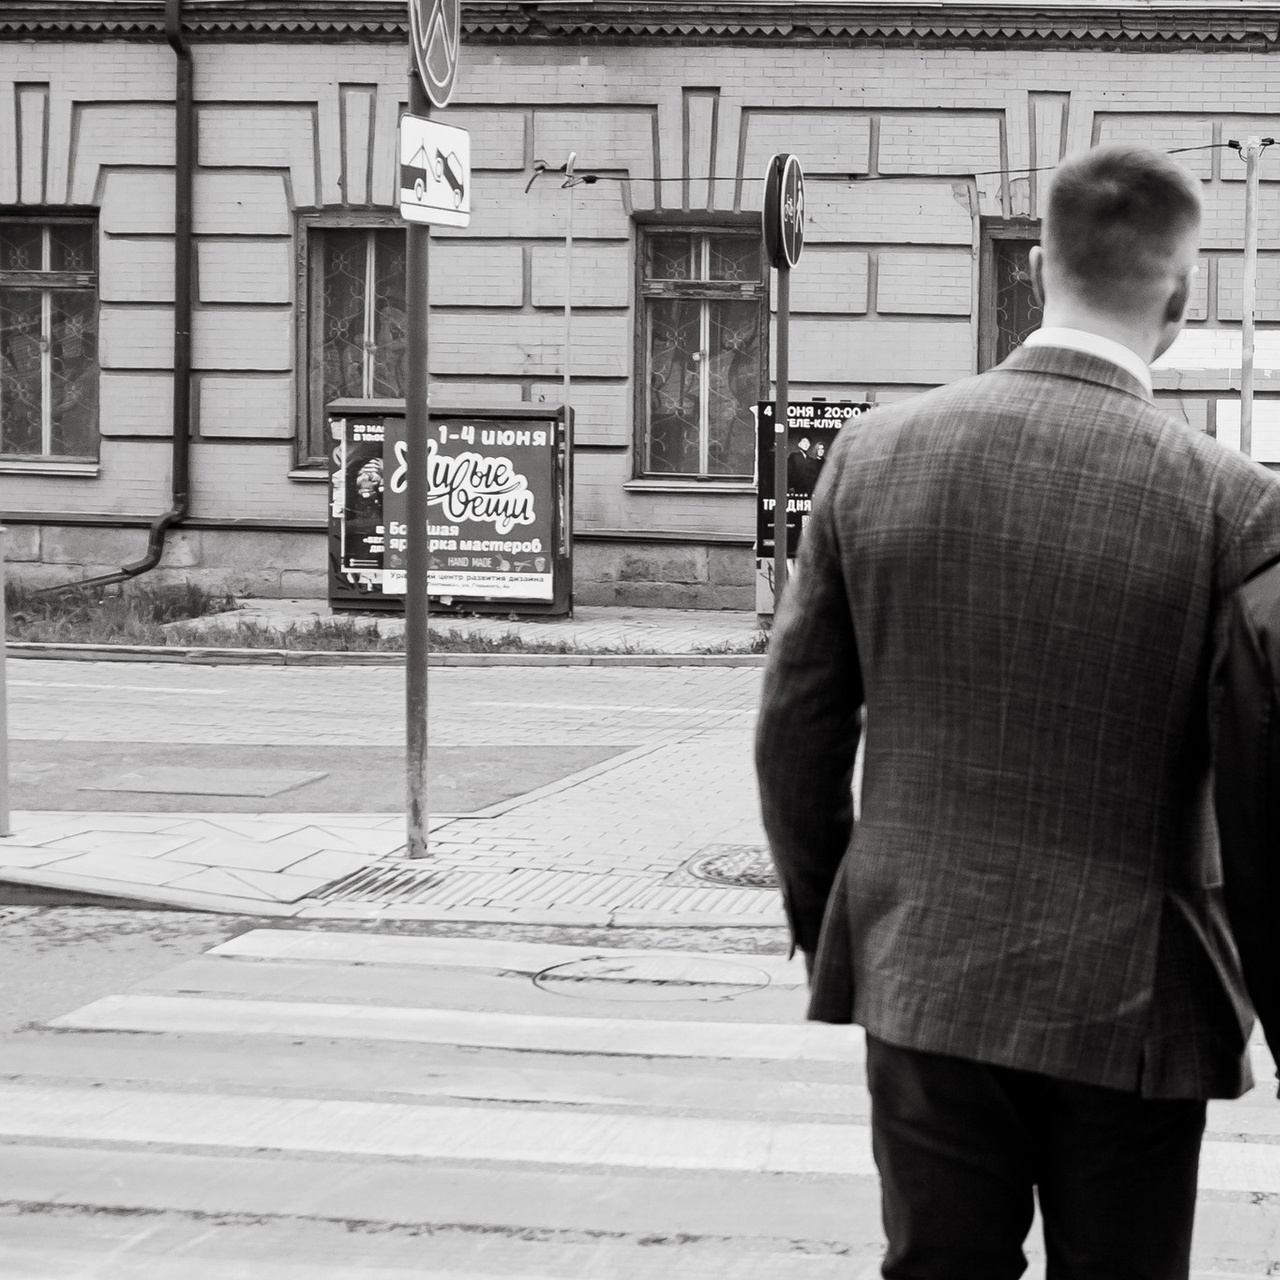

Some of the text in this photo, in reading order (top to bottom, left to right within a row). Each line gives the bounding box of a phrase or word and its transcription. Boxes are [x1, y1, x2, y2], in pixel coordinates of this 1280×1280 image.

[763, 405, 773, 416] 4
[824, 407, 861, 418] 20:00
[438, 425, 547, 446] 1-4 июня
[389, 520, 460, 536] Бошая
[389, 538, 458, 552] яррка
[459, 538, 542, 554] мастеров
[447, 556, 493, 569] HAND MADE
